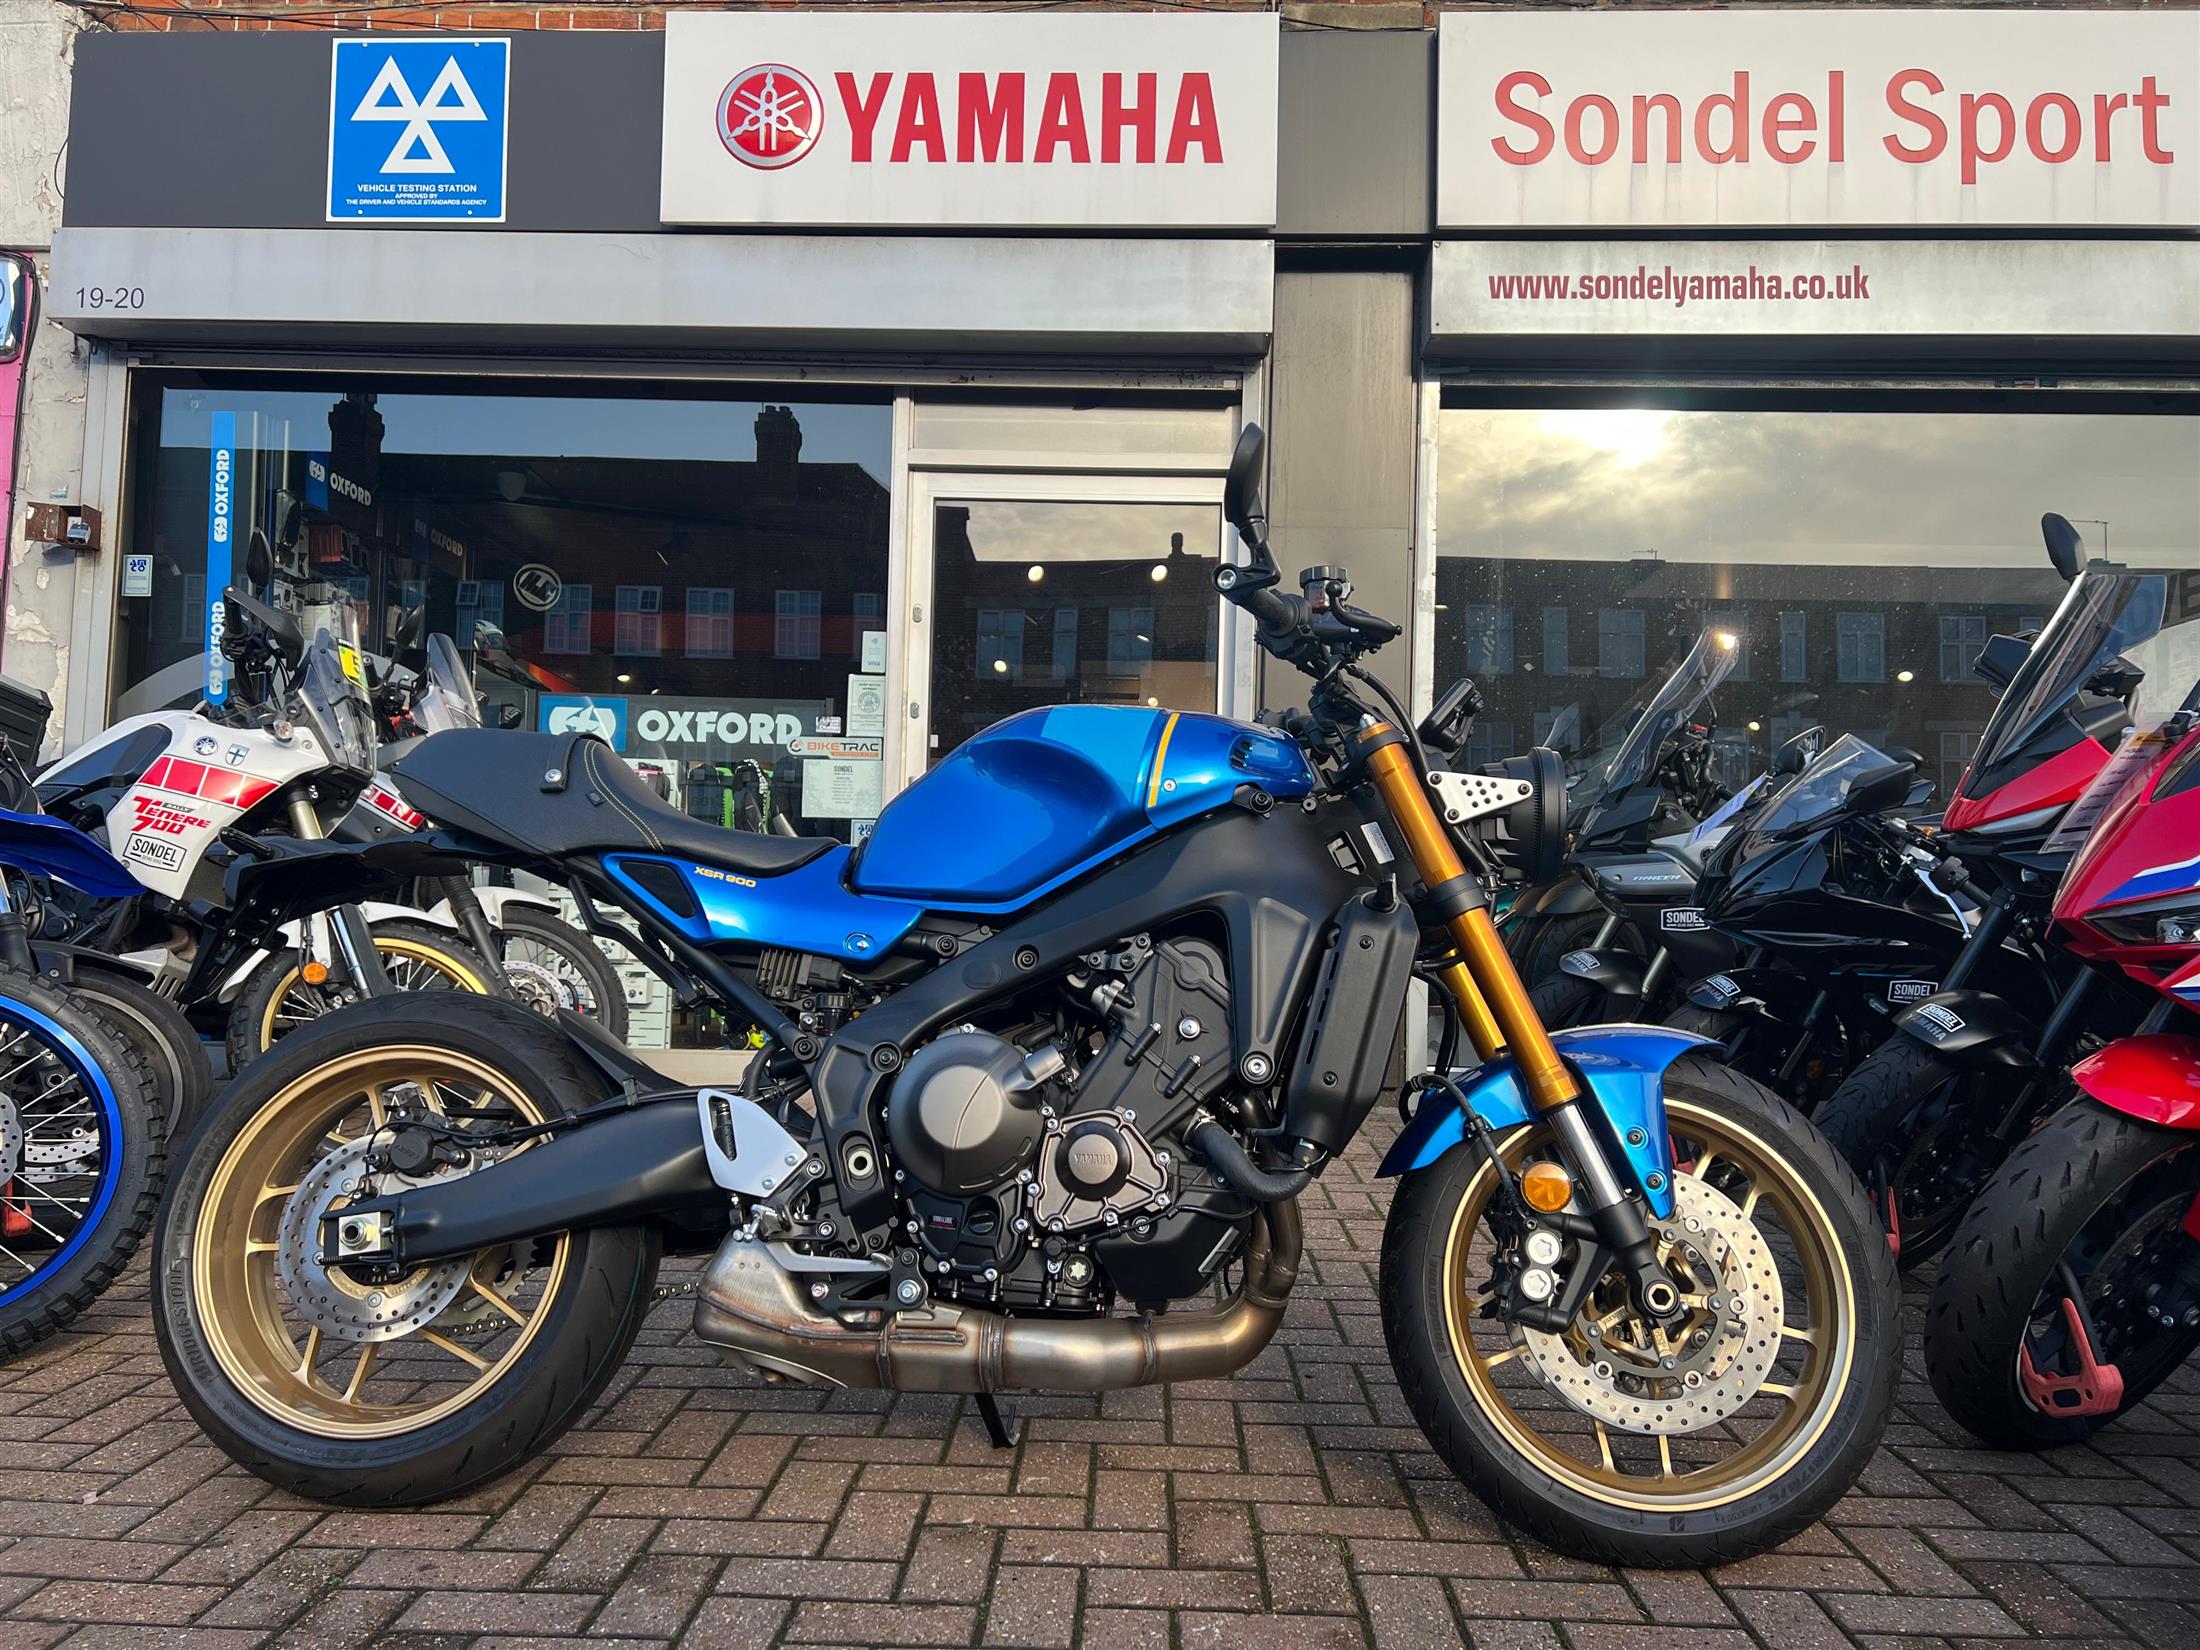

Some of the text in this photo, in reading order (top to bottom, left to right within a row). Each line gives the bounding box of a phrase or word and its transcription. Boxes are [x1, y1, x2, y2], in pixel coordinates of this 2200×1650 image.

[833, 71, 1224, 164] YAMAHA
[1490, 68, 2175, 185] Sondel Sport
[357, 184, 477, 192] VEHICLE TESTING STATION
[75, 287, 145, 309] 19-20
[1488, 265, 1870, 308] www.sondelyamaha.co.uk
[215, 449, 230, 515] OXFORD
[329, 472, 372, 507] OXFORD
[430, 528, 463, 557] OXFORD
[637, 709, 802, 745] OXFORD
[807, 742, 879, 752] BIKETRAC
[132, 838, 176, 863] SONDEL
[693, 866, 757, 888] XSR 900
[1666, 911, 1705, 923] SONDEL
[1894, 983, 1931, 997] SONDEL
[1925, 1004, 1959, 1027] SONDEL
[1074, 1153, 1112, 1166] YAMAHA
